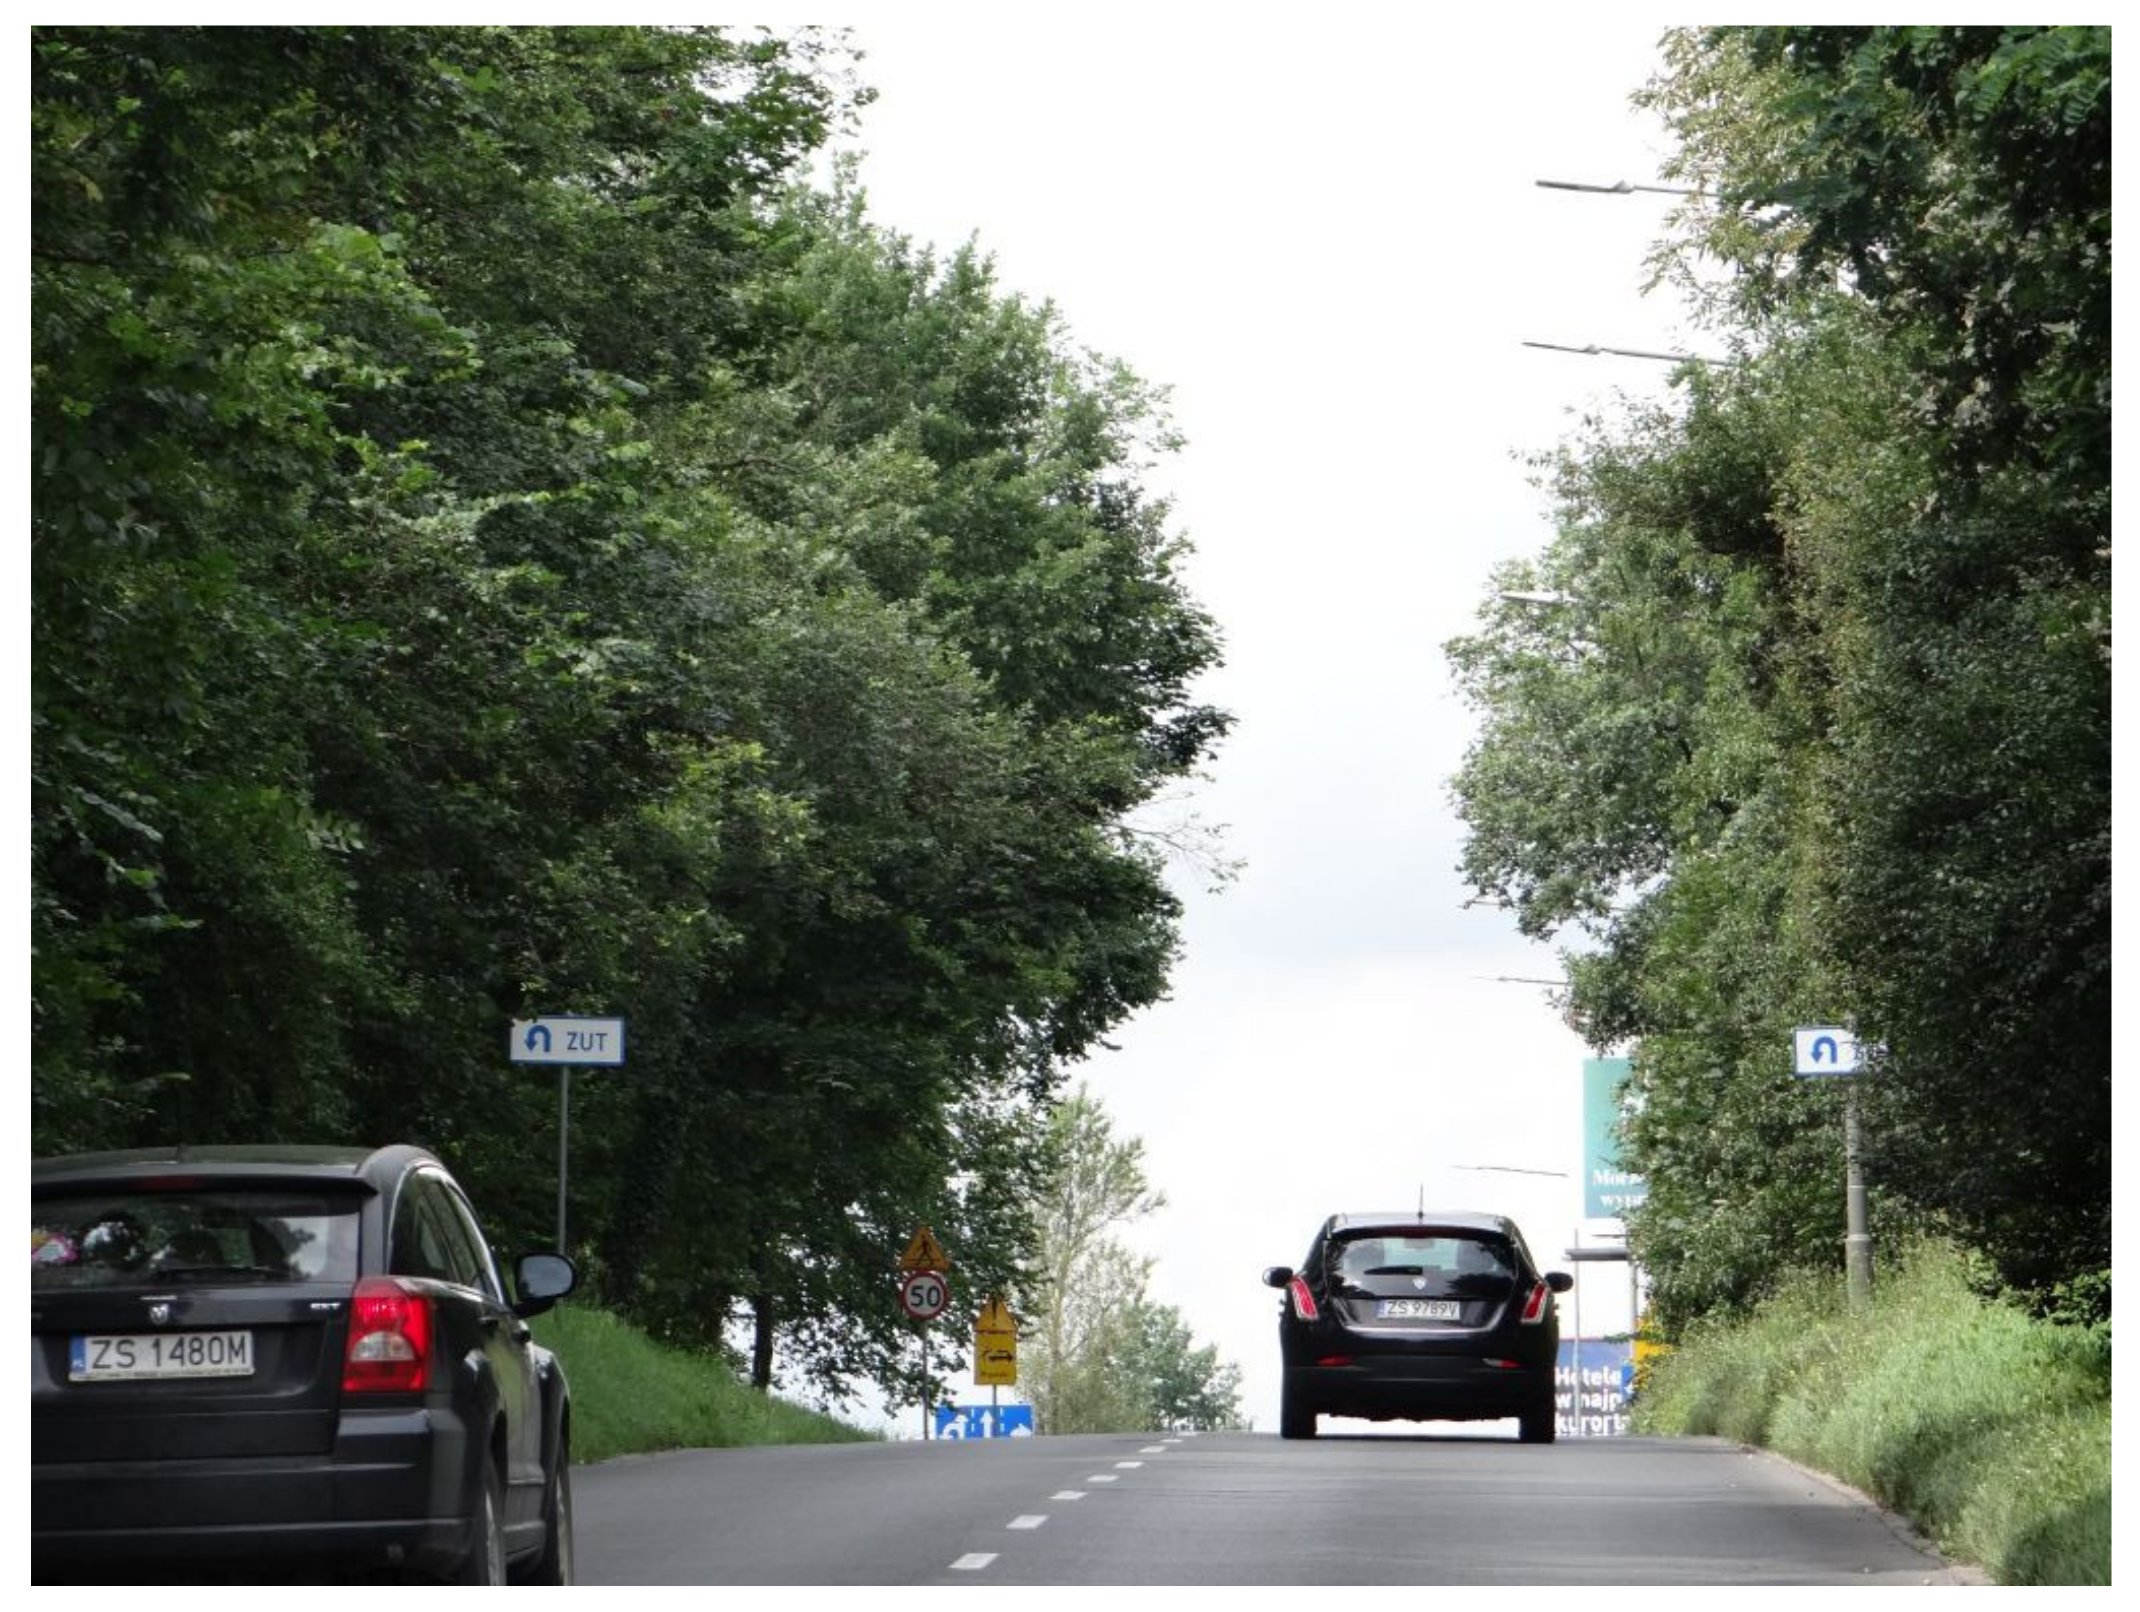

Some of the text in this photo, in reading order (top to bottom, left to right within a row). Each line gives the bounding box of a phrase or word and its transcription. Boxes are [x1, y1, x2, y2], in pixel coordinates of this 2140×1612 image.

[566, 1031, 608, 1051] ZUT
[909, 1286, 941, 1308] 50
[1387, 1301, 1407, 1314] ZS
[90, 1335, 247, 1370] ZS 1480M
[1554, 1366, 1622, 1387] Hotele
[1554, 1392, 1572, 1409] w
